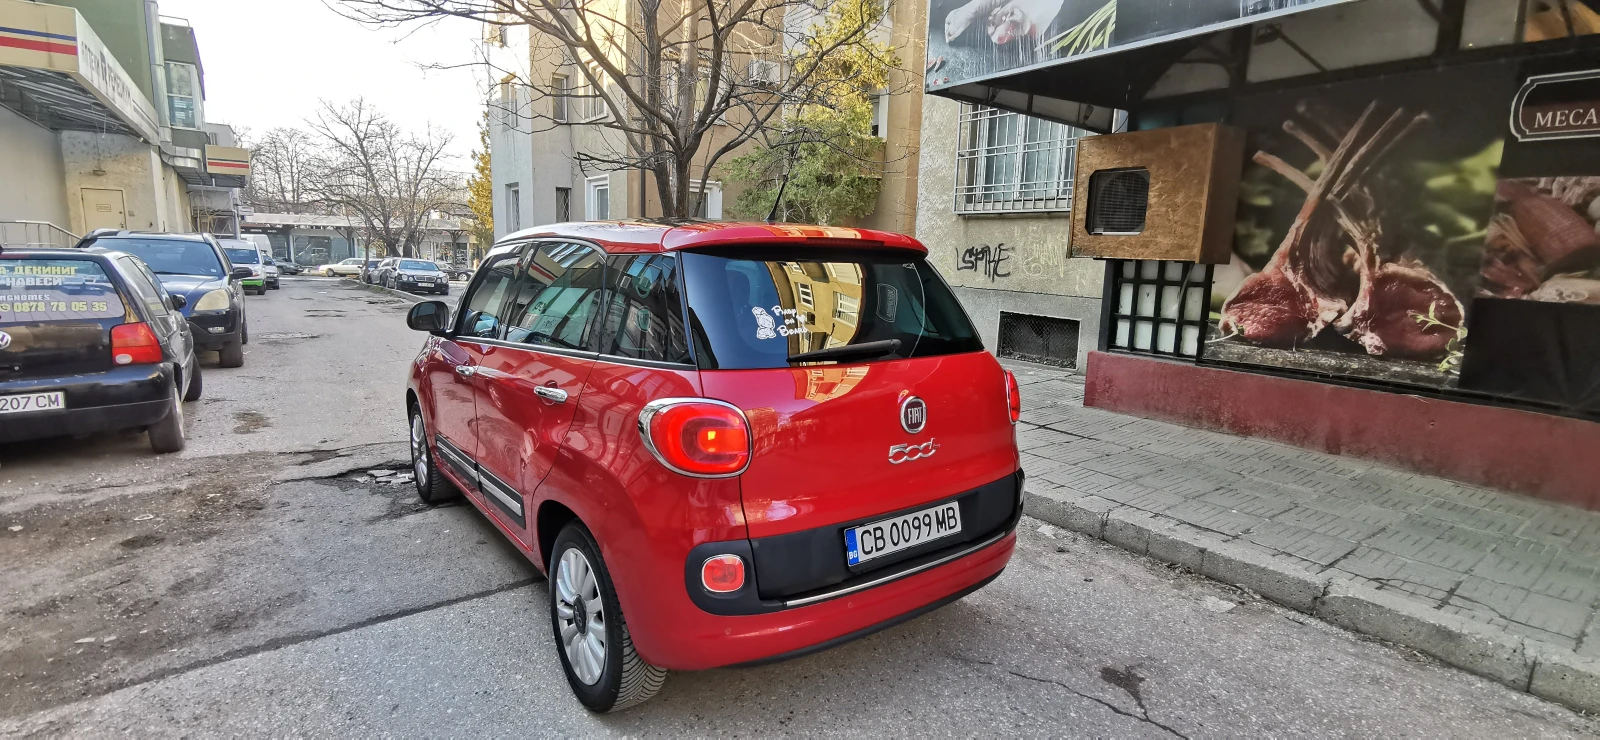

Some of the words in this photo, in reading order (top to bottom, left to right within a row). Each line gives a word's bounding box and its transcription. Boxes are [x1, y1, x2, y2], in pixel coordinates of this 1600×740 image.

[14, 302, 46, 312] 0878
[51, 302, 66, 312] 78
[71, 302, 87, 311] 05
[92, 302, 107, 311] 35
[0, 396, 31, 411] 207
[36, 394, 60, 408] CM
[907, 406, 923, 425] FIAT
[860, 526, 886, 555] CB
[889, 513, 932, 547] 0099
[935, 506, 958, 533] MB
[848, 550, 858, 560] BG
